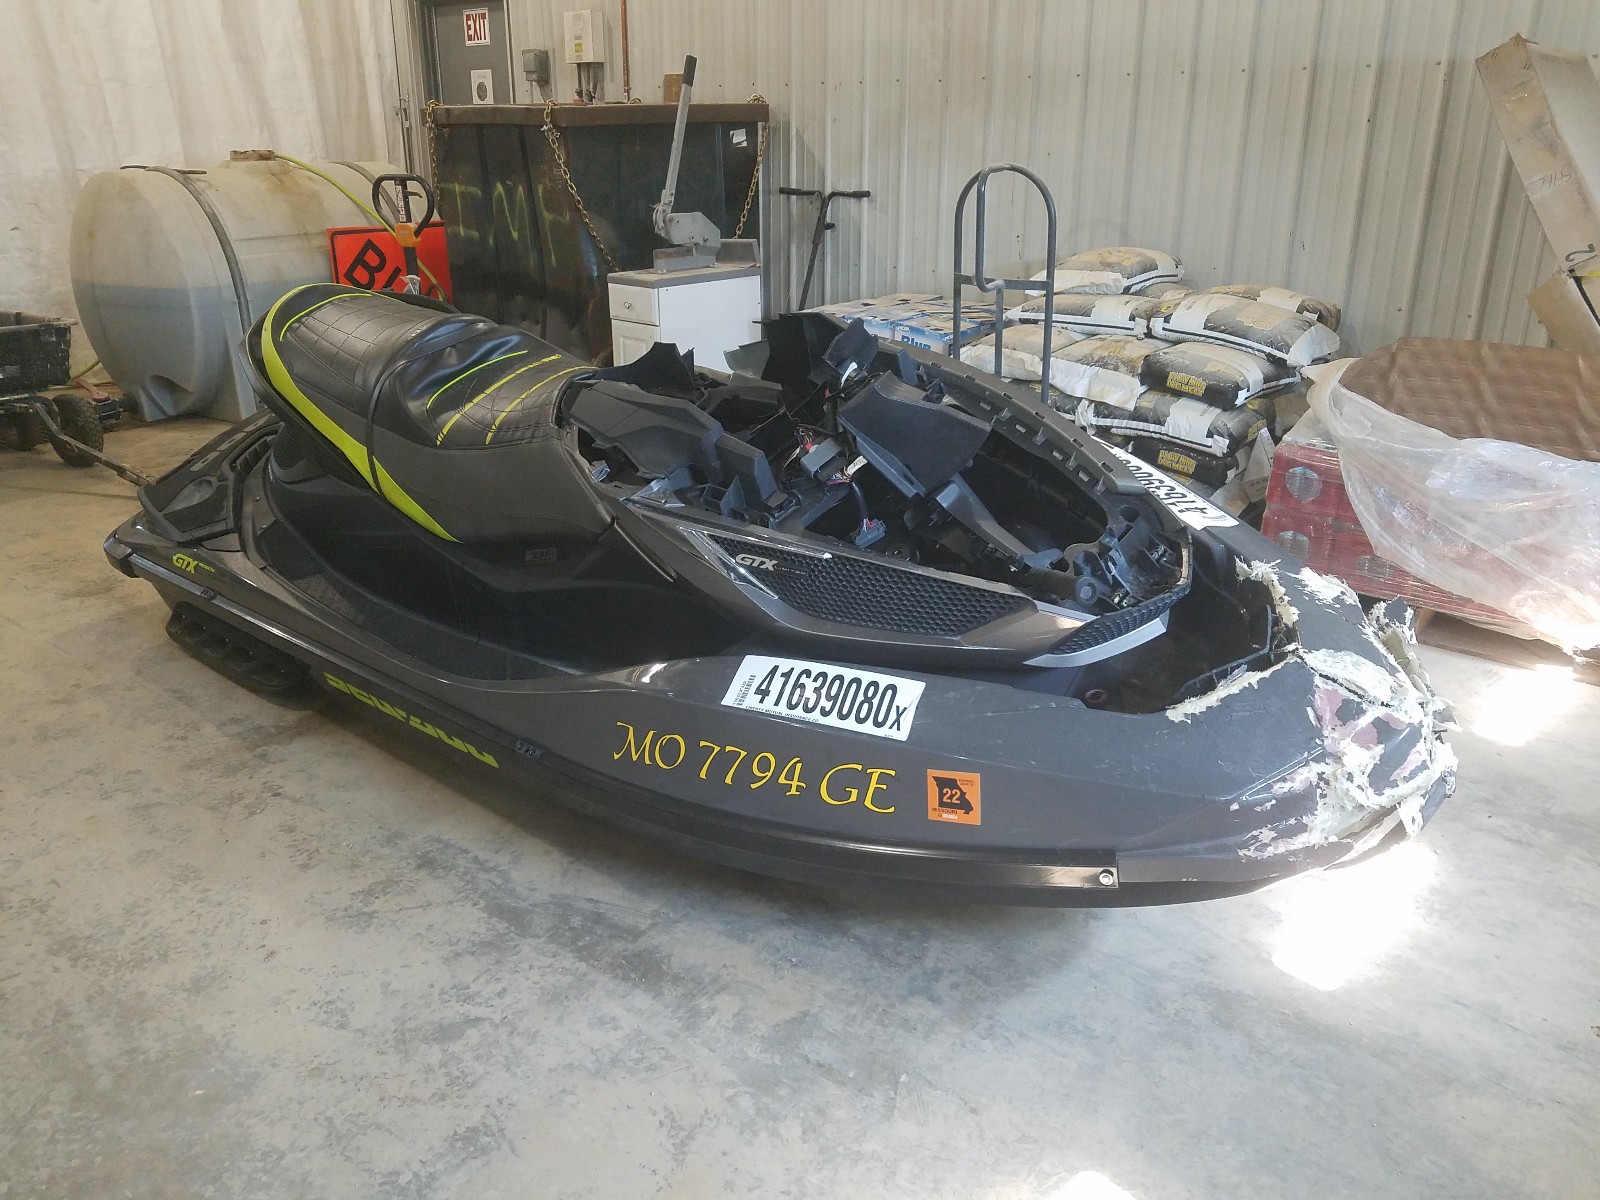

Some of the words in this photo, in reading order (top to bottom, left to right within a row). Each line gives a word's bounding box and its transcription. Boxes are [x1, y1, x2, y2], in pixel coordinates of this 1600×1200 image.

[465, 11, 487, 41] EXIT
[172, 553, 199, 574] GTX
[735, 553, 779, 572] GTX
[613, 721, 687, 770] MO
[699, 740, 807, 796] 7794
[819, 763, 897, 813] GE
[942, 787, 961, 804] 22
